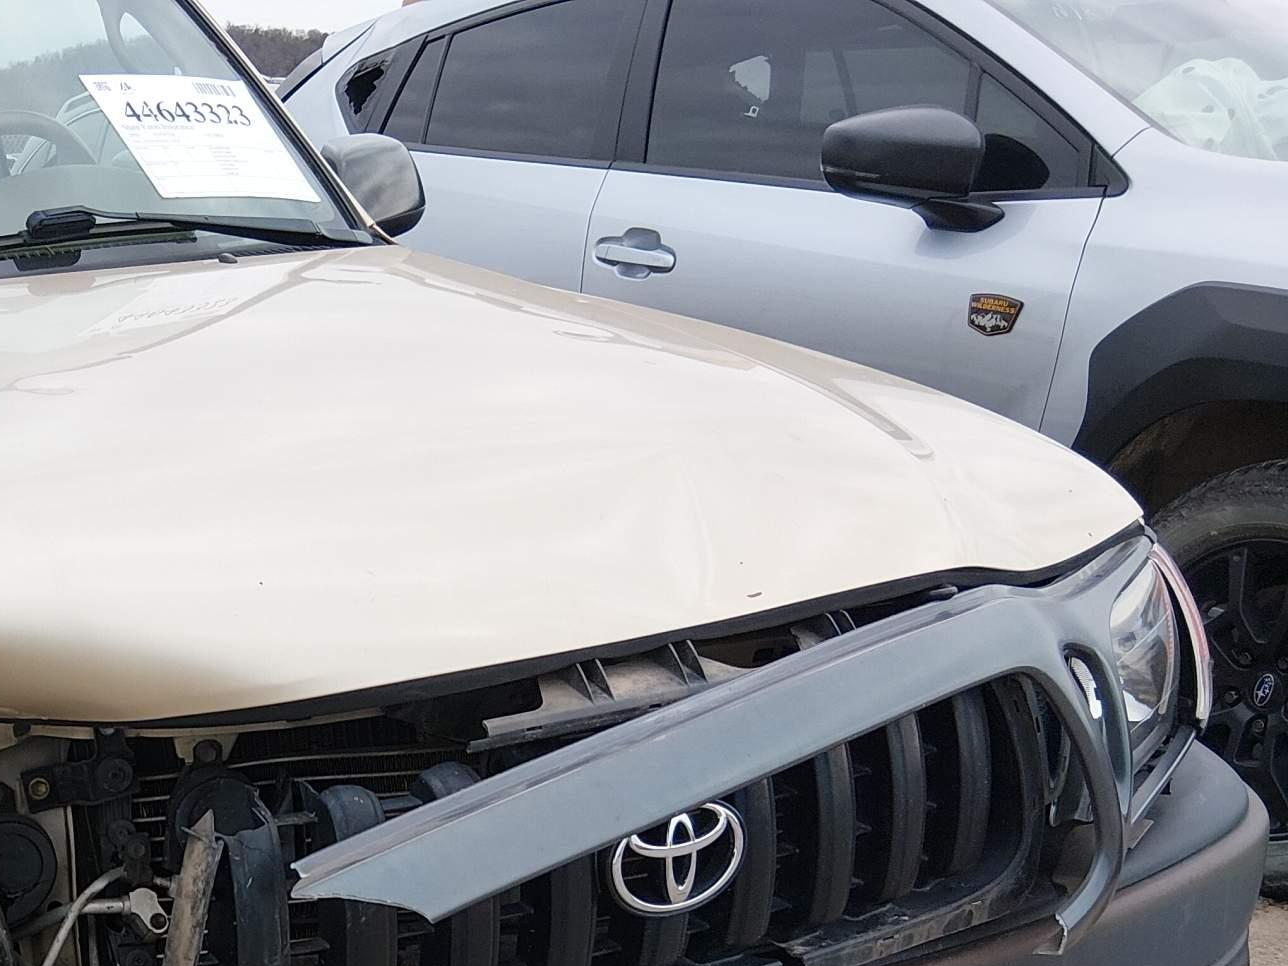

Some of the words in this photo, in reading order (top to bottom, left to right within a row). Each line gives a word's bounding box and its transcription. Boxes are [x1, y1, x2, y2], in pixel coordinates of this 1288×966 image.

[124, 100, 252, 127] 44643323
[972, 301, 1017, 314] WILDERNESS
[980, 297, 1009, 307] SUBARU
